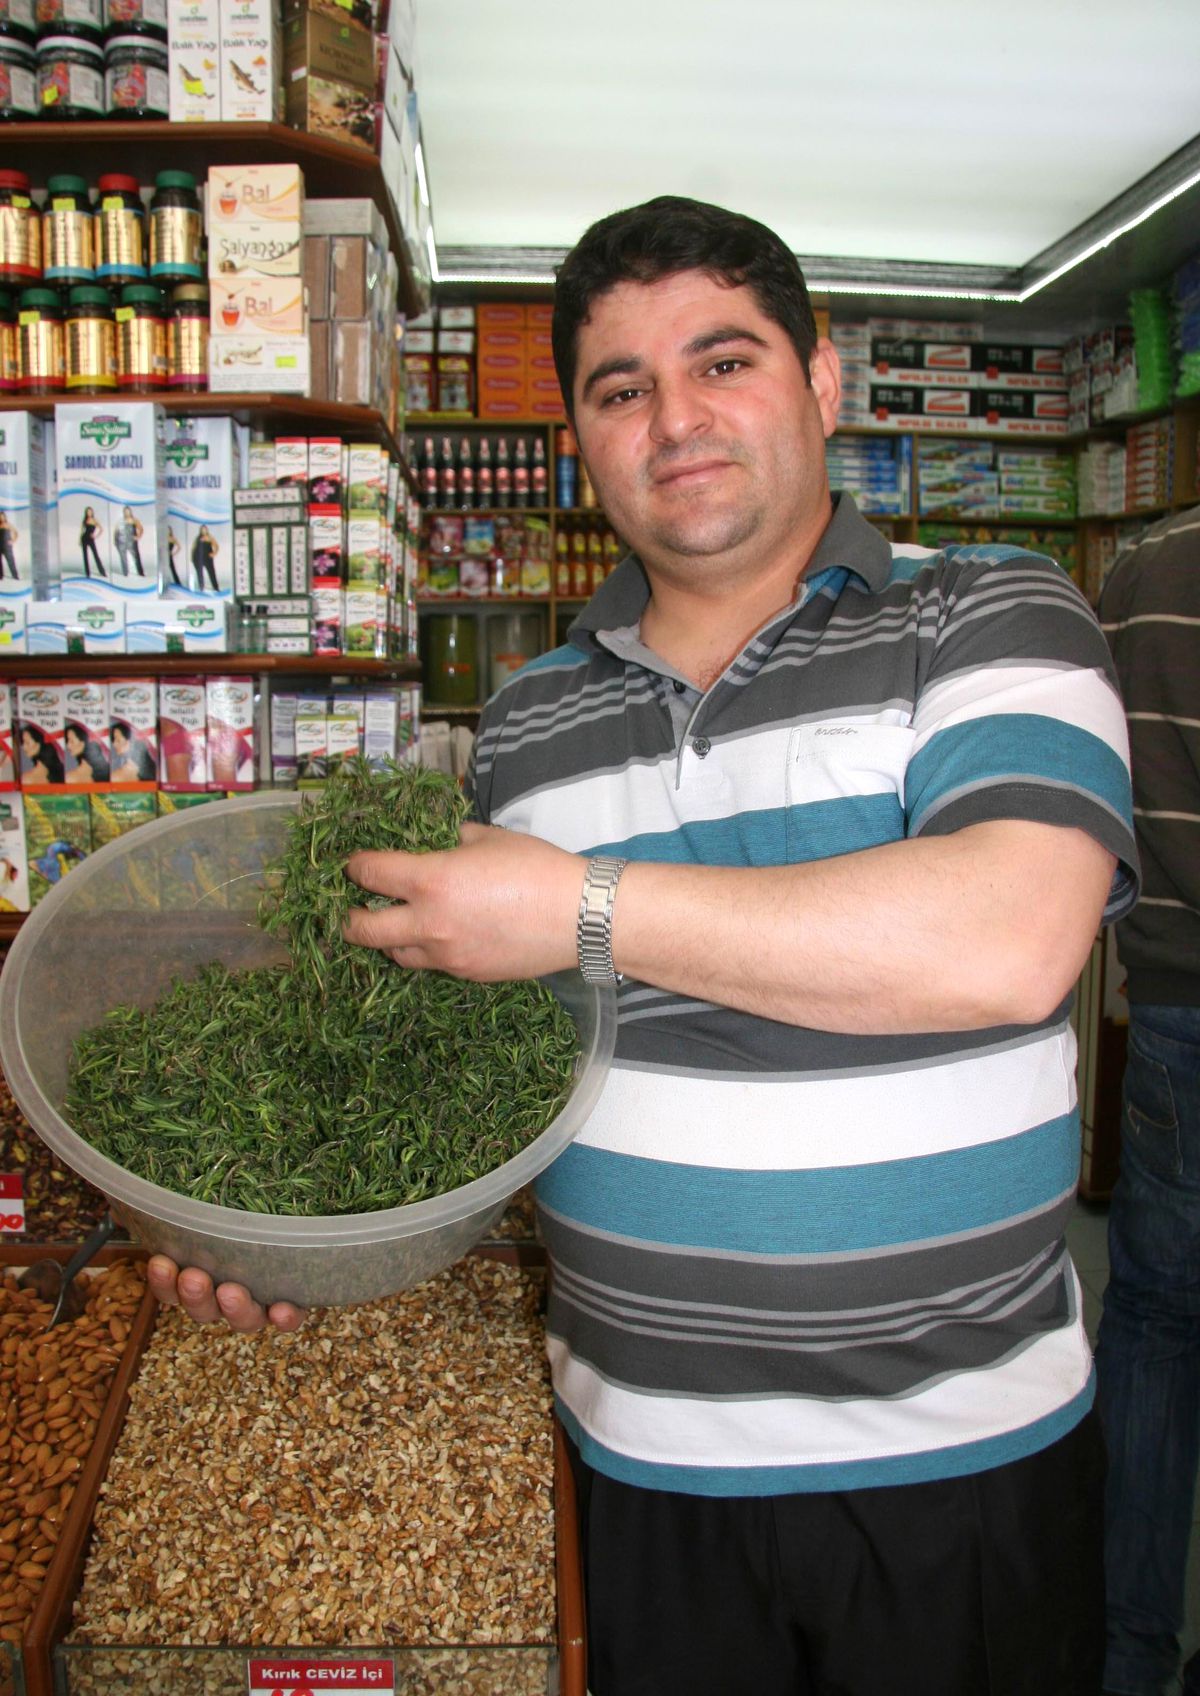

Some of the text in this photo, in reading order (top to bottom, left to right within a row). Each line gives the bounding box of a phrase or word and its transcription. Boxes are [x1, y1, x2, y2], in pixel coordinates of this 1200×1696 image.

[242, 184, 270, 203] Bal
[245, 296, 272, 317] Bal
[262, 1666, 383, 1681] Kırık CEVİZ İçi
